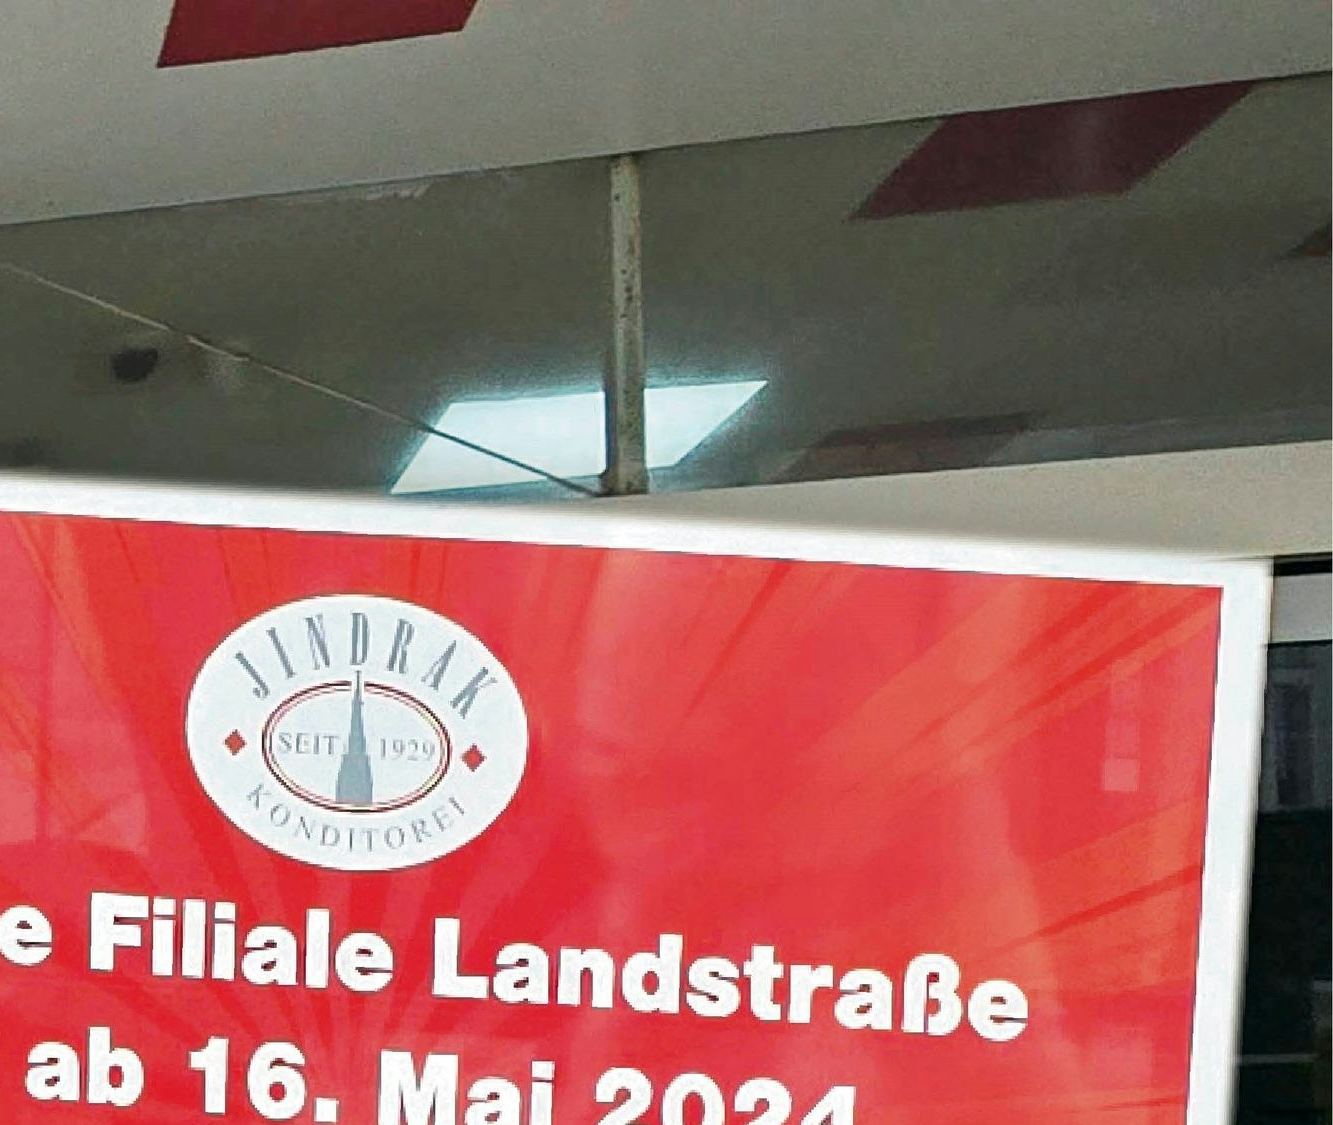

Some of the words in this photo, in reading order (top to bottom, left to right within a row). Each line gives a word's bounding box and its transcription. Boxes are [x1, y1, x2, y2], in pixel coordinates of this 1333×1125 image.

[234, 611, 497, 720] JINDRAK
[278, 730, 339, 757] SEIT
[380, 737, 435, 762] 1929
[247, 782, 466, 853] KONDITOREI
[89, 891, 394, 993] Filiale
[433, 917, 1029, 1042] Landstraße
[25, 1026, 144, 1107] ab
[189, 1036, 338, 1125] 16.
